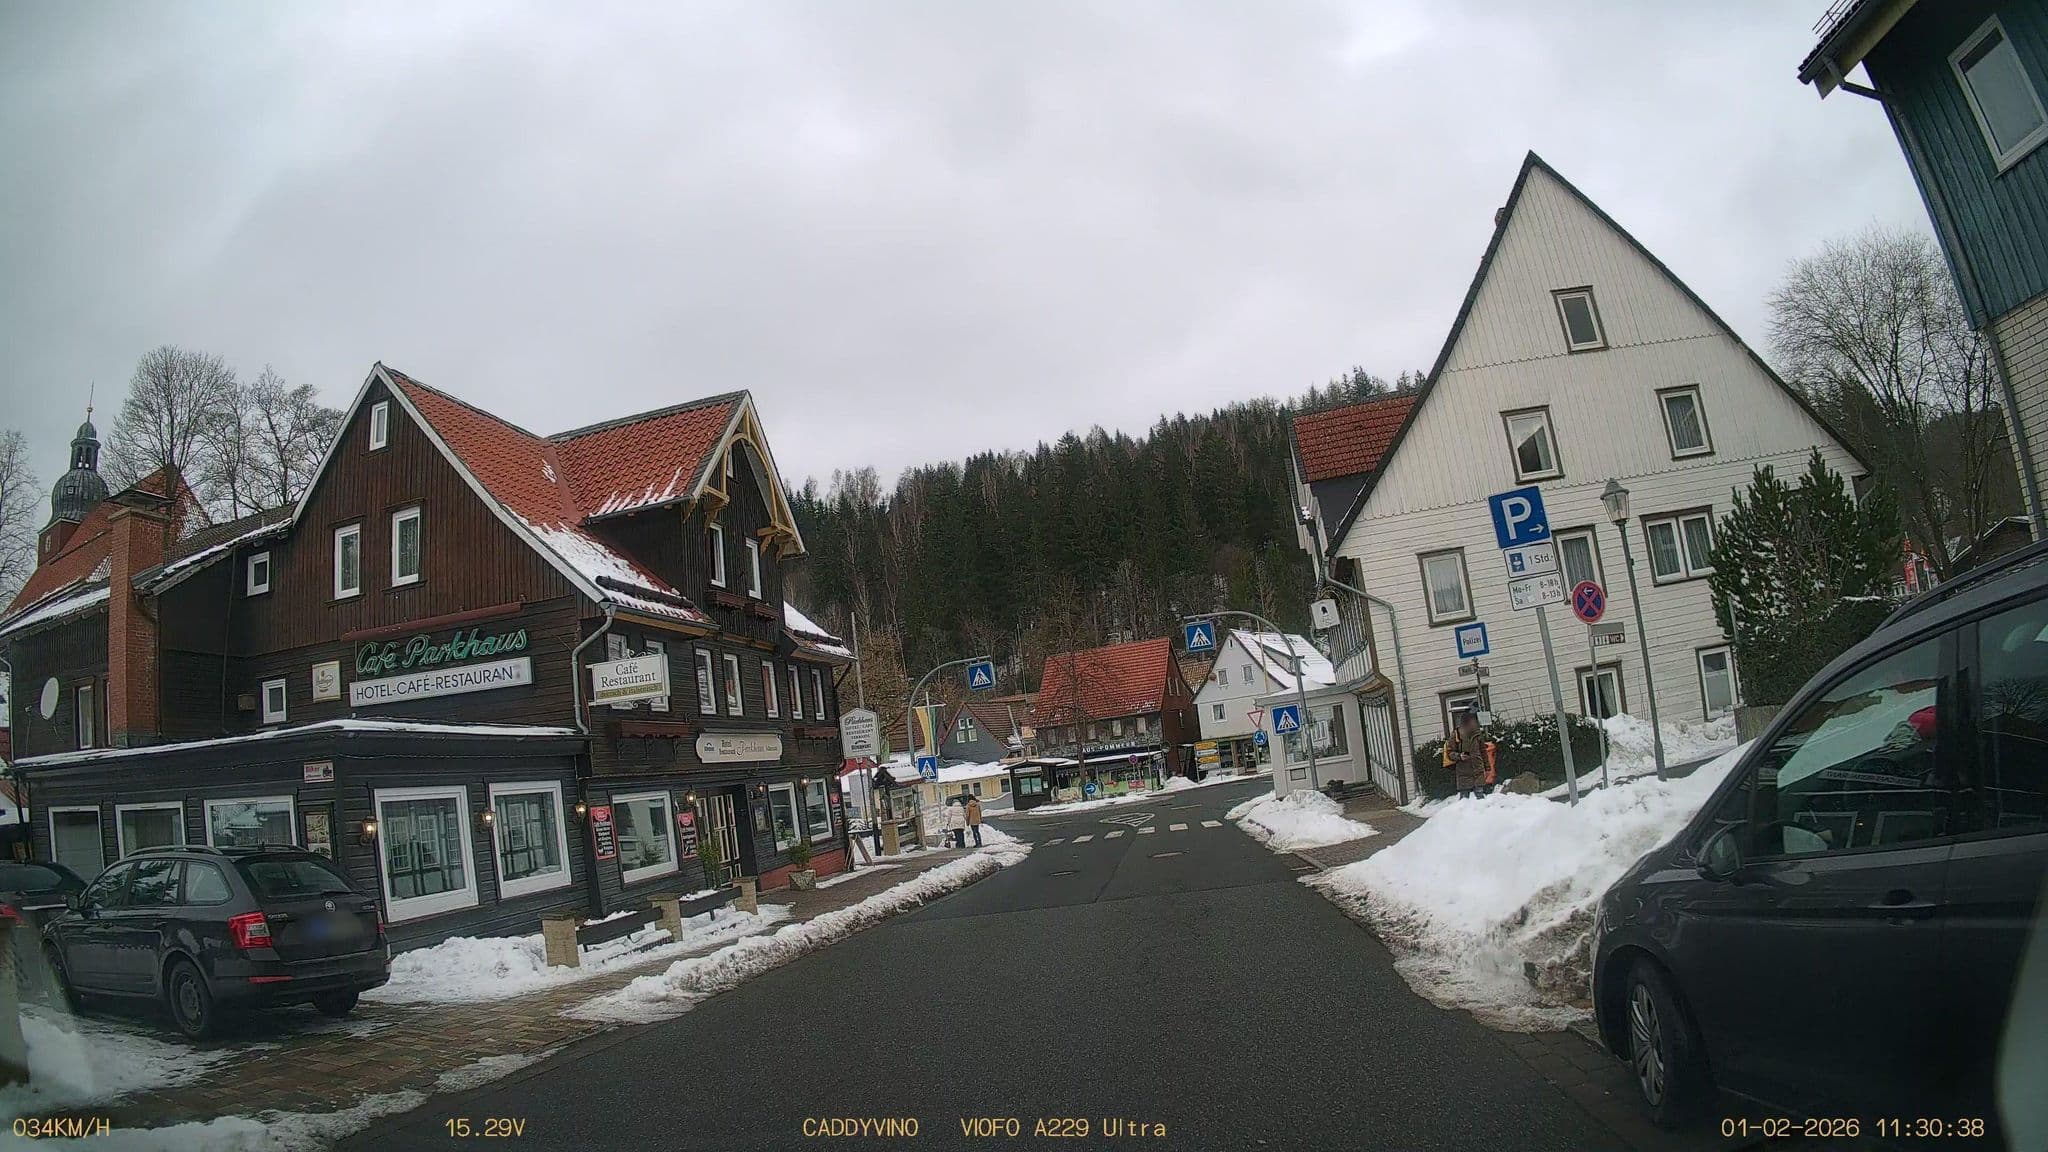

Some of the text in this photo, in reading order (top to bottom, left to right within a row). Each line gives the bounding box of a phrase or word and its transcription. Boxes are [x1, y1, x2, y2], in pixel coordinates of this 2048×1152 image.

[1502, 497, 1532, 540] P
[402, 628, 527, 668] Parkhaus
[1463, 636, 1482, 646] Polizei
[615, 661, 639, 676] Café
[601, 672, 656, 688] Restaurant
